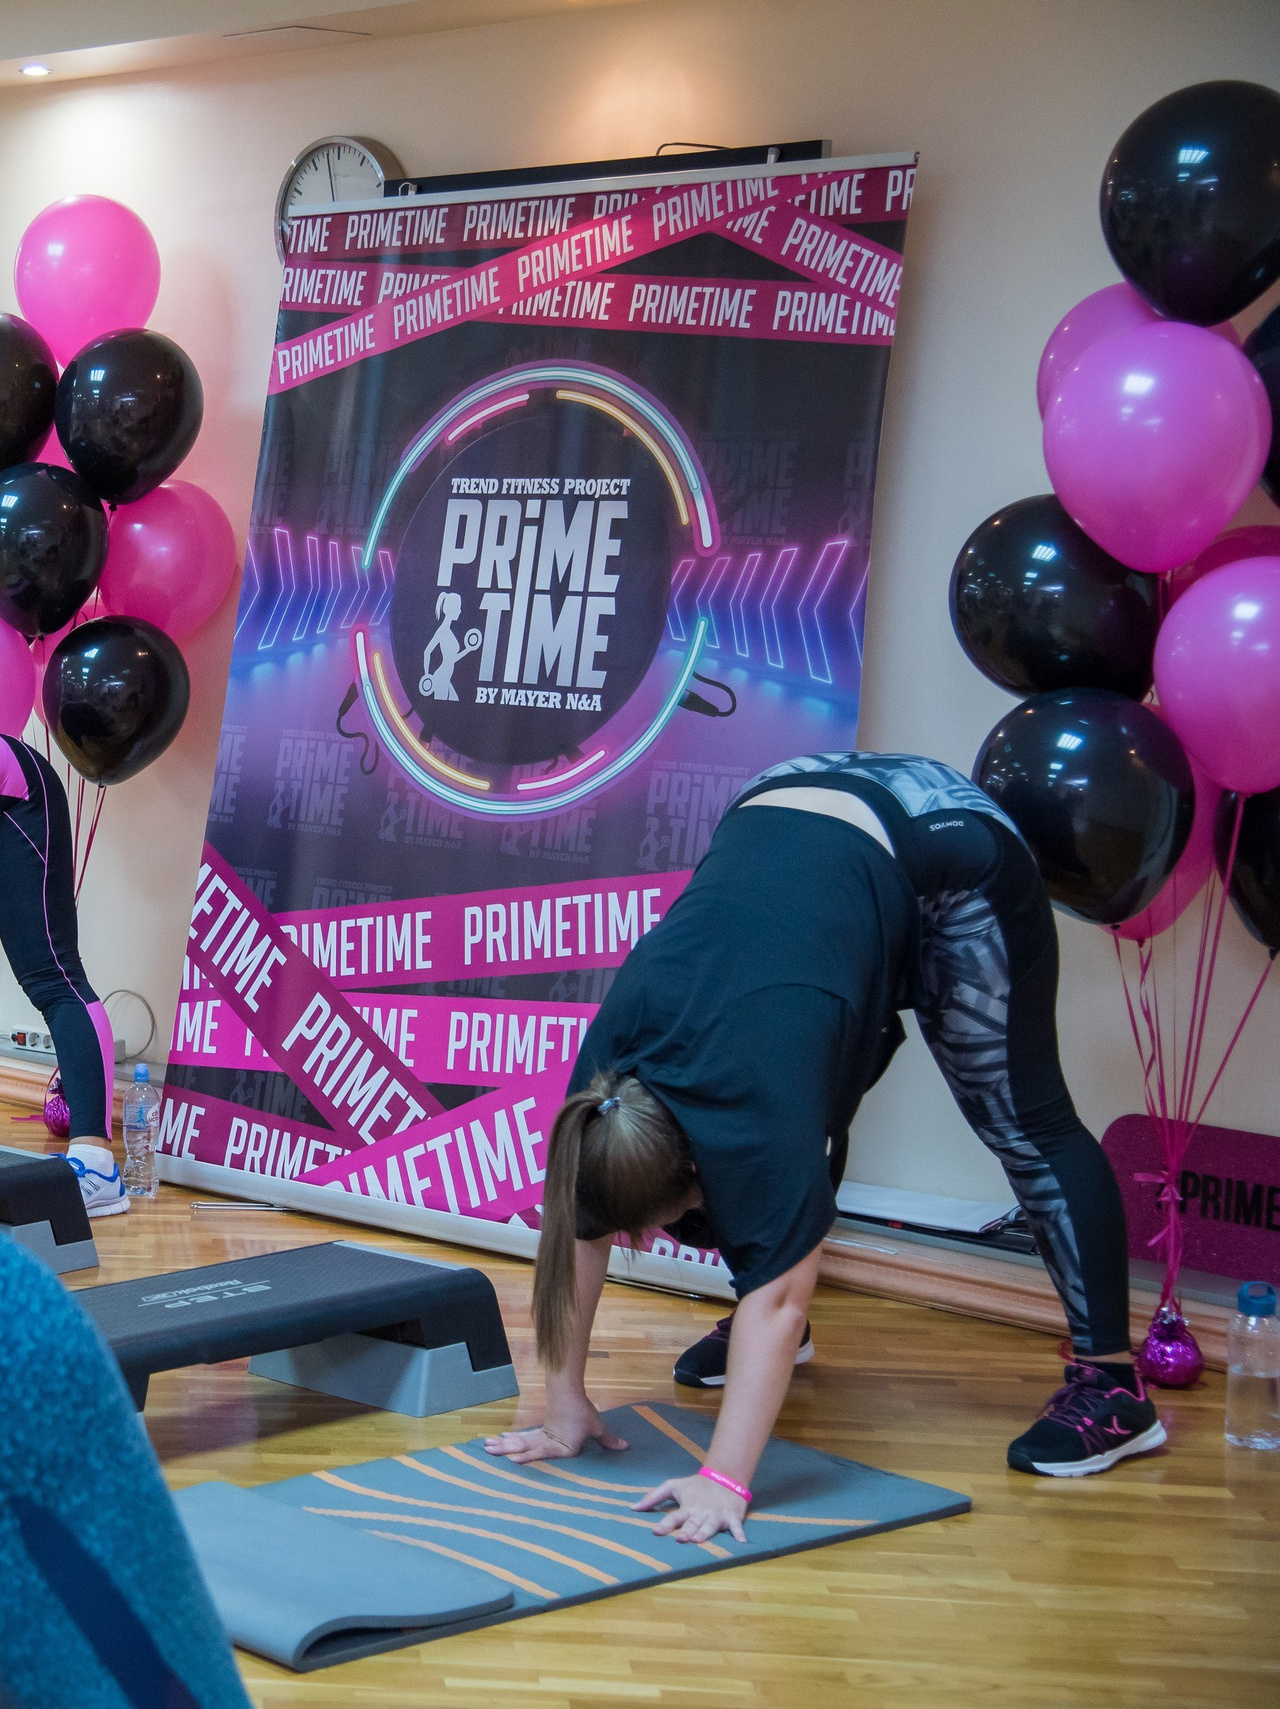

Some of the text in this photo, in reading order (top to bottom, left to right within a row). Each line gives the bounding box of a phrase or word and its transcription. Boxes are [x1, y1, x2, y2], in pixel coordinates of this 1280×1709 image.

[345, 208, 449, 250] PRIMETIME
[463, 197, 576, 242] PRIMETIME
[277, 176, 779, 384] PRIMETIME PRIMETIME PRIMETIME PRIMETIME
[628, 284, 757, 329] PRIMETIME
[451, 478, 631, 499] TREND FITNESS PROJECT
[478, 592, 616, 688] TIME
[475, 687, 602, 711] BY MAYER N&A
[929, 820, 964, 832] DOMYOS
[165, 1284, 272, 1308] STEP
